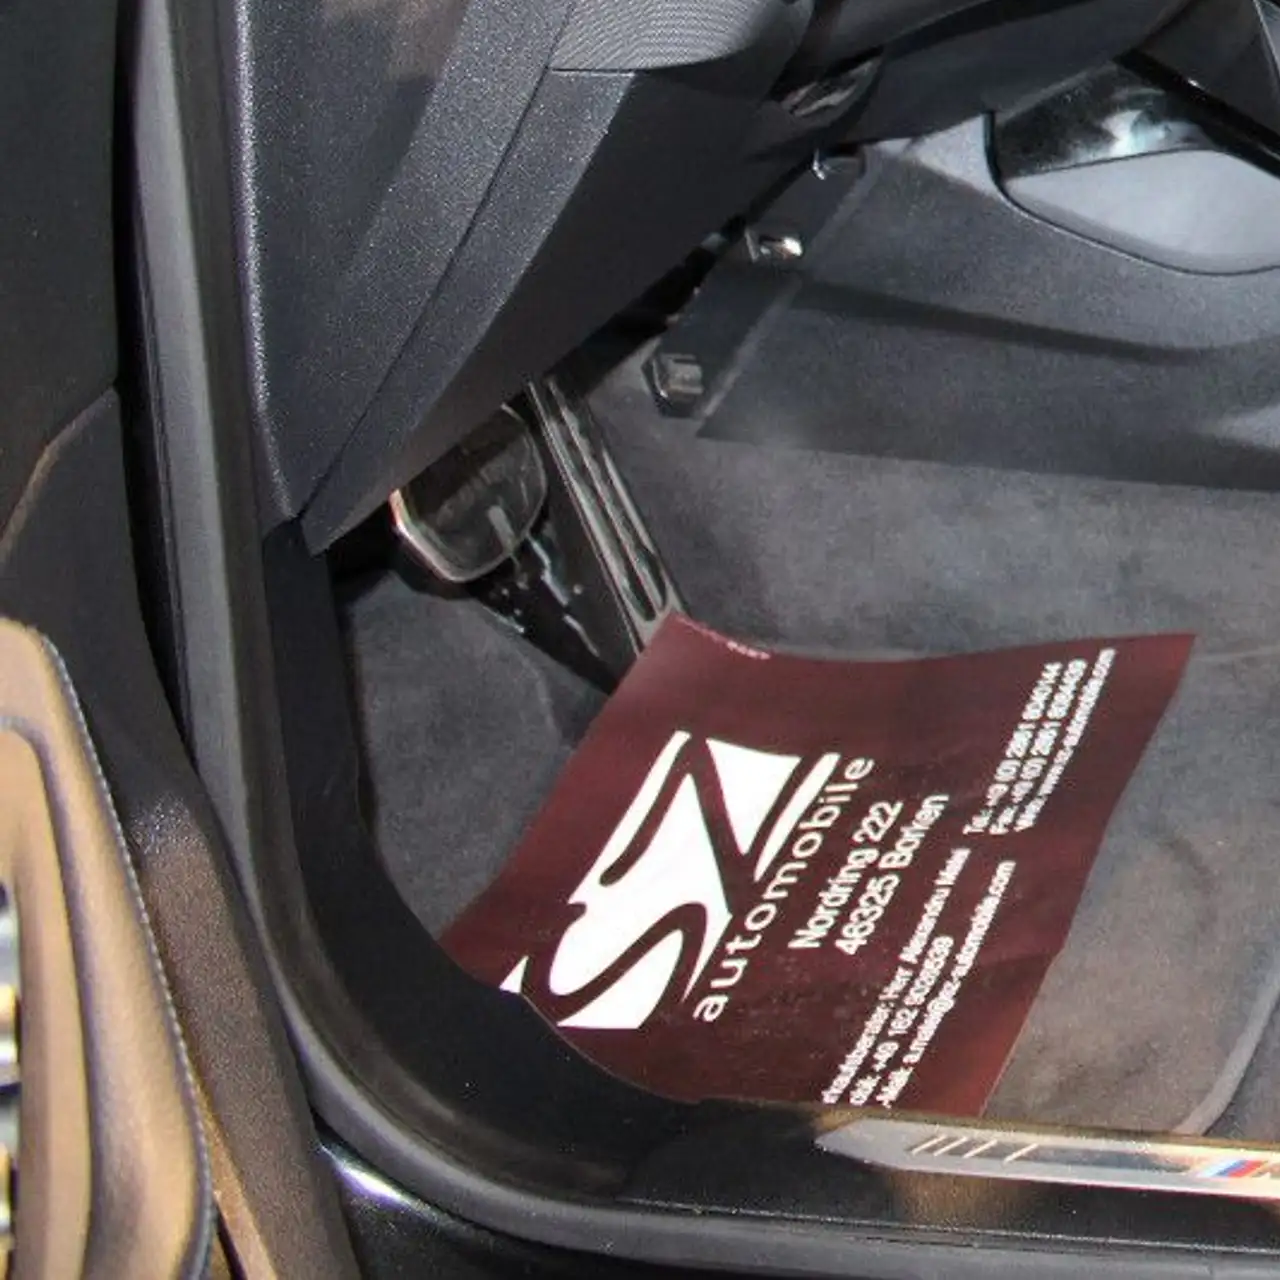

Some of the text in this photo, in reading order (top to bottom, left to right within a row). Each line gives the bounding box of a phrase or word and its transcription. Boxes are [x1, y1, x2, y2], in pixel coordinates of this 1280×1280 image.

[994, 755, 1022, 783] (0)
[1018, 757, 1047, 781] (0)
[692, 757, 875, 1022] automobile
[787, 801, 904, 949] Nordring 222
[834, 794, 950, 956] 46325 Borken
[878, 966, 913, 1001] Herr
[849, 1074, 882, 1107] obil:
[872, 1041, 900, 1073] +49
